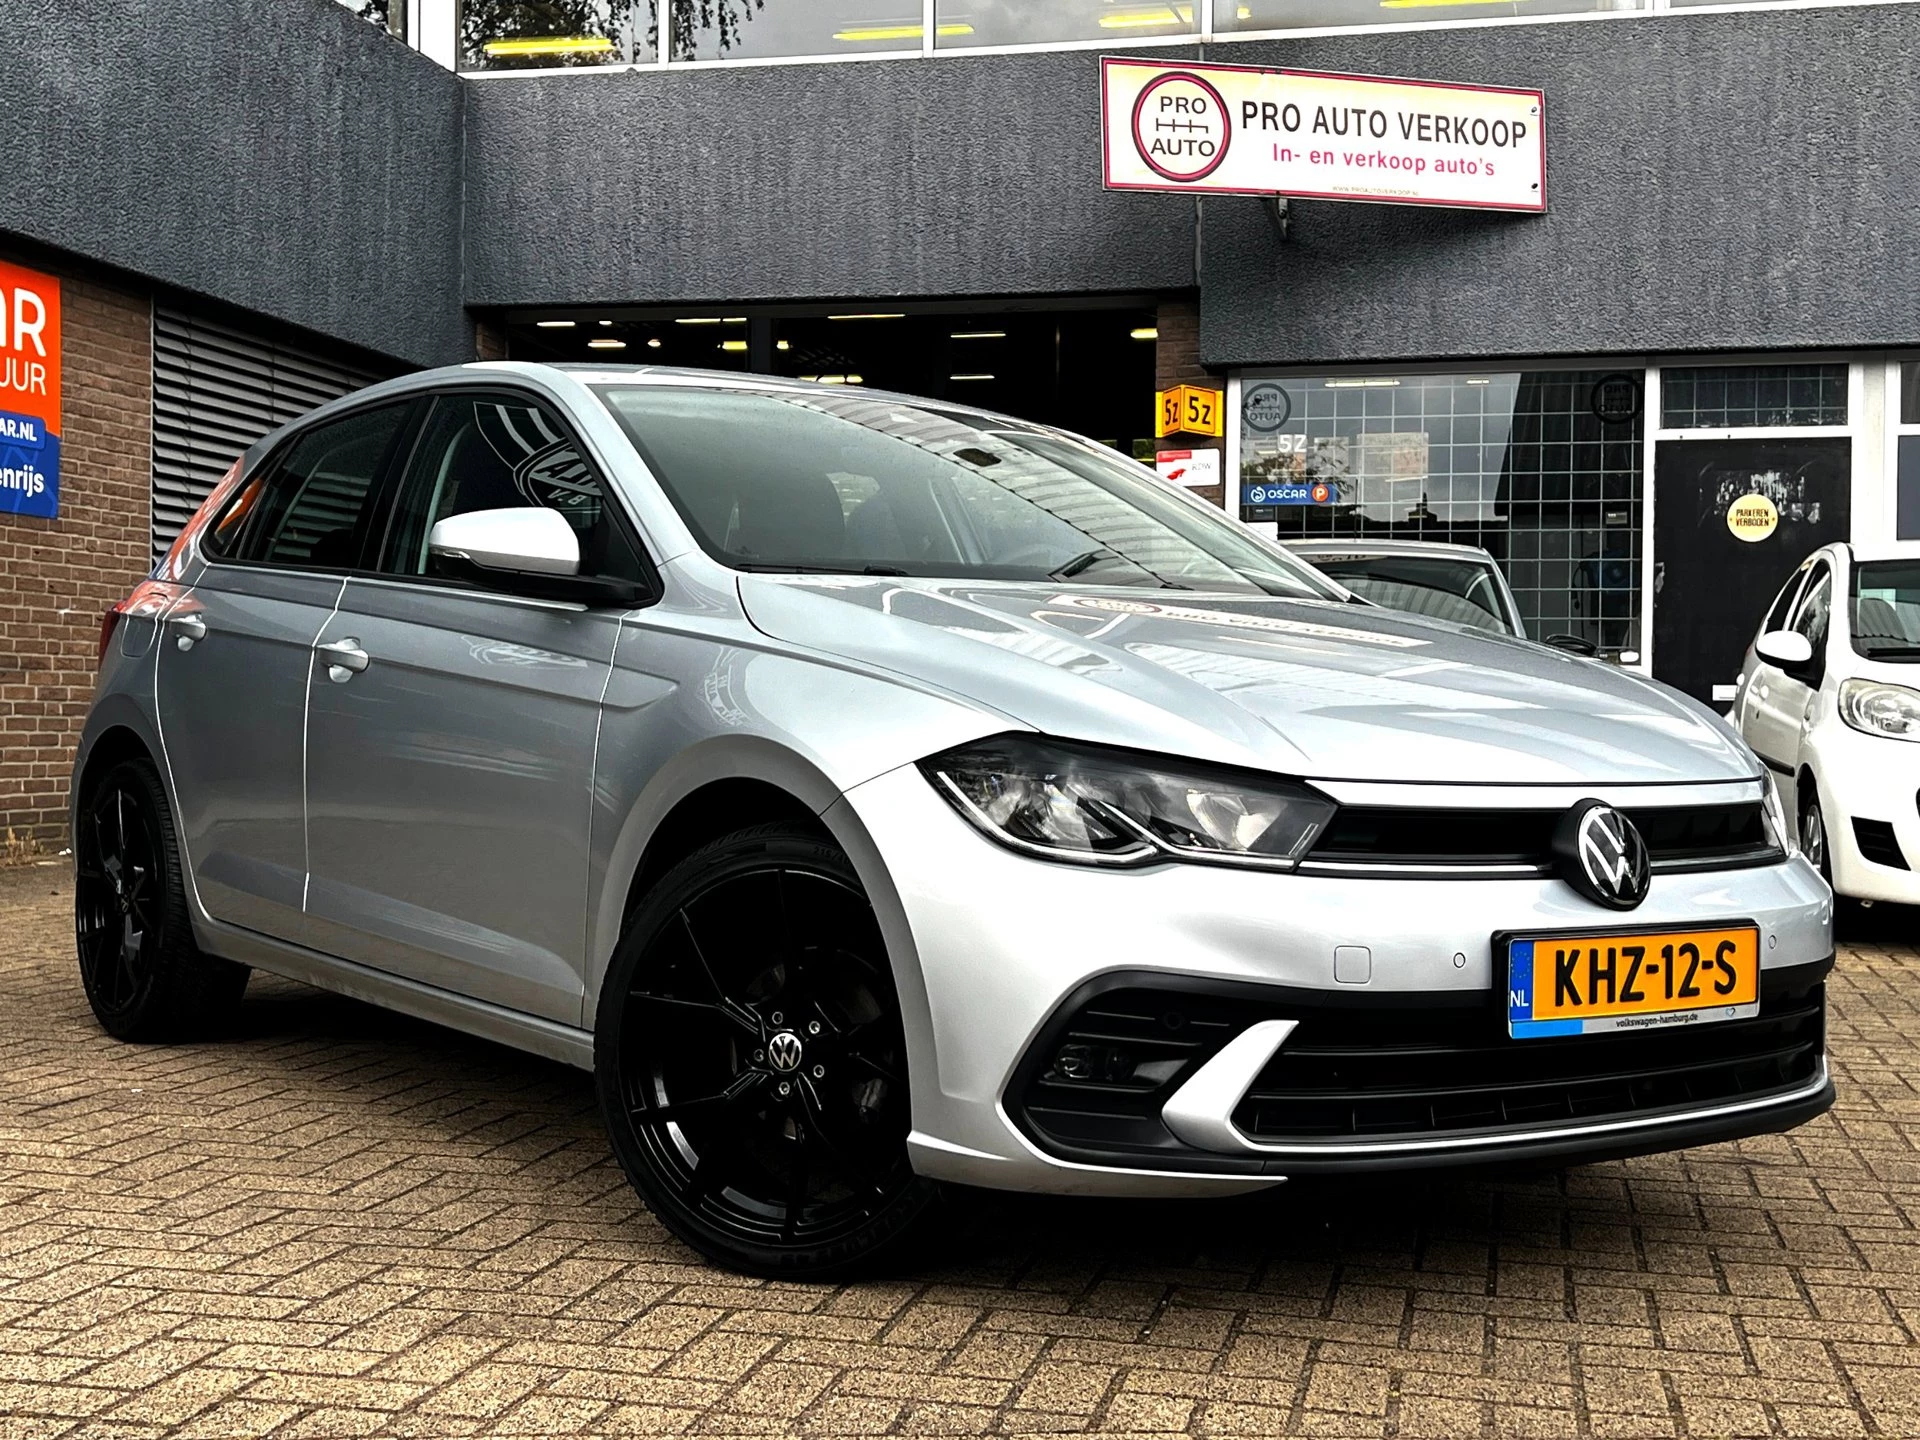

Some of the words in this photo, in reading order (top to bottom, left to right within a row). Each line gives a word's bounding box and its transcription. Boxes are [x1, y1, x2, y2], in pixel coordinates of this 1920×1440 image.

[1160, 96, 1207, 114] PRO
[1242, 101, 1301, 132] PRO
[1313, 105, 1387, 138] AUTO
[1398, 112, 1526, 148] VERKOOP
[1151, 138, 1215, 157] AUTO
[1273, 143, 1301, 162] In-
[1310, 150, 1334, 165] en
[1343, 150, 1426, 175] verkoop
[1434, 157, 1495, 176] auto's
[1268, 489, 1307, 499] OSCAR
[1736, 508, 1769, 517] PARKEREN
[1736, 518, 1769, 527] VERBODEN
[1555, 940, 1736, 1007] KHZ-12-S
[1510, 989, 1529, 1008] NL
[1616, 1013, 1699, 1028] volkswagen-hamburg.de
